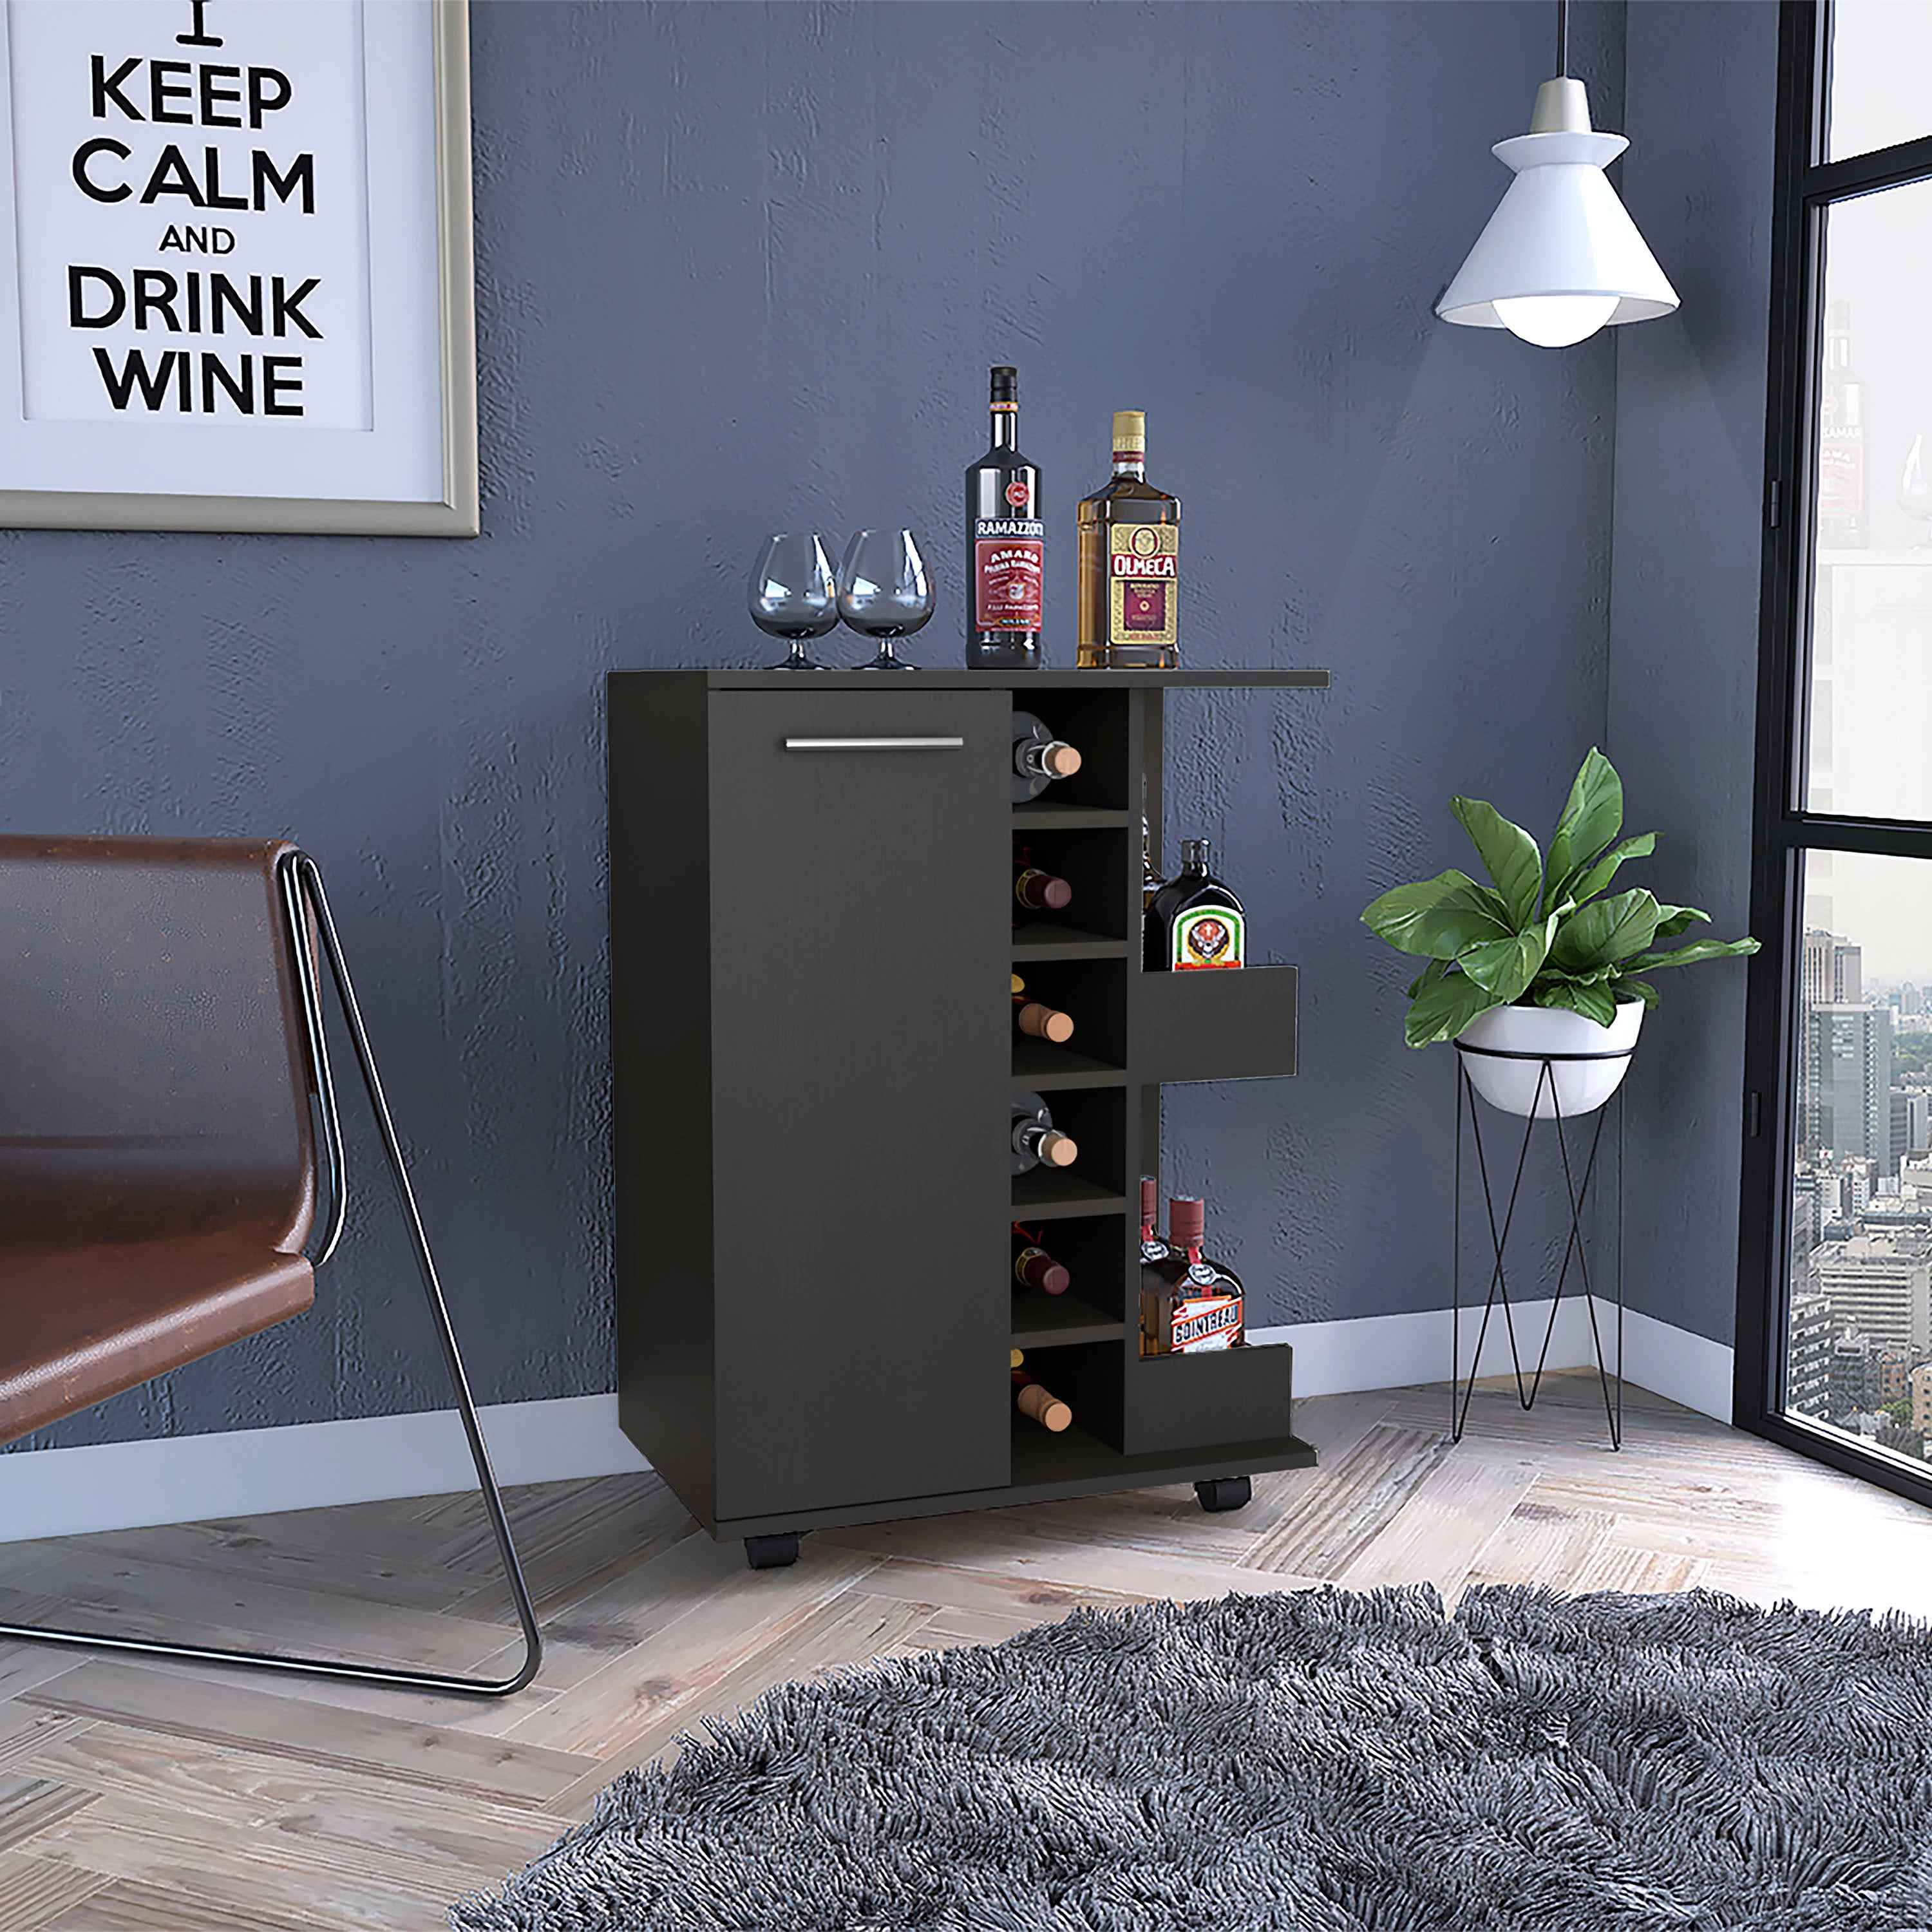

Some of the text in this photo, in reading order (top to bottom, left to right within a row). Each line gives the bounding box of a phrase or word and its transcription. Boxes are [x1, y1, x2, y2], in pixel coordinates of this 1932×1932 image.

[91, 54, 292, 129] KEEP
[72, 138, 315, 214] CALM
[158, 224, 235, 254] AND
[68, 265, 324, 339] DRINK
[92, 347, 303, 416] WINE
[1114, 554, 1175, 576] OLMECA
[1175, 1305, 1238, 1343] COINTREAU
